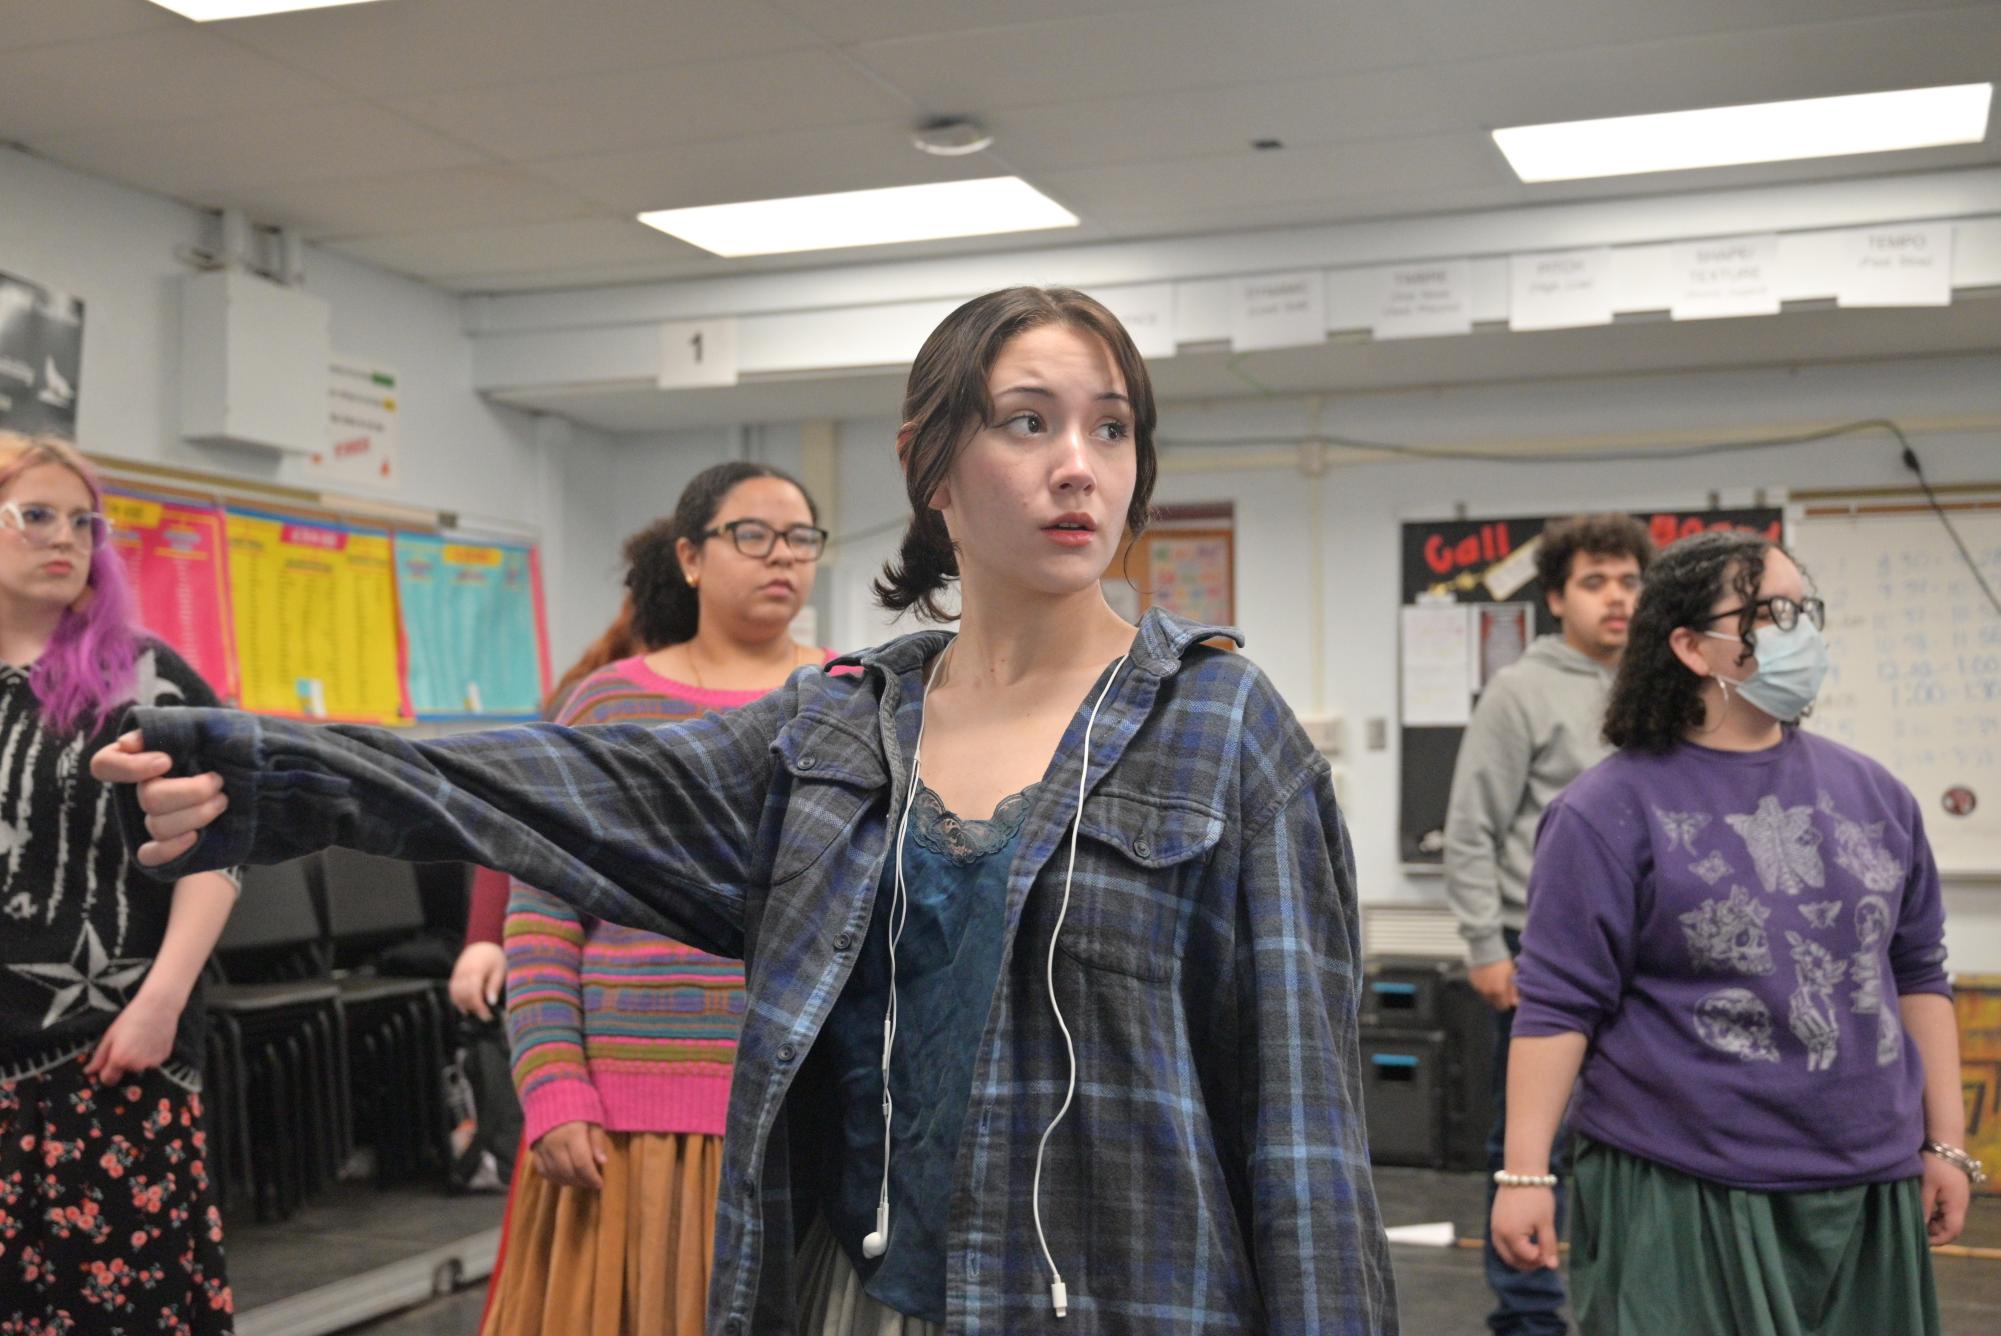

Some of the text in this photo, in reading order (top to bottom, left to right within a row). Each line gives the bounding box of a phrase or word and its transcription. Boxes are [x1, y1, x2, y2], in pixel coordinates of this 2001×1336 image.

[1868, 232, 1927, 251] TEMPO
[688, 332, 704, 364] 1
[1424, 521, 1510, 575] Call
